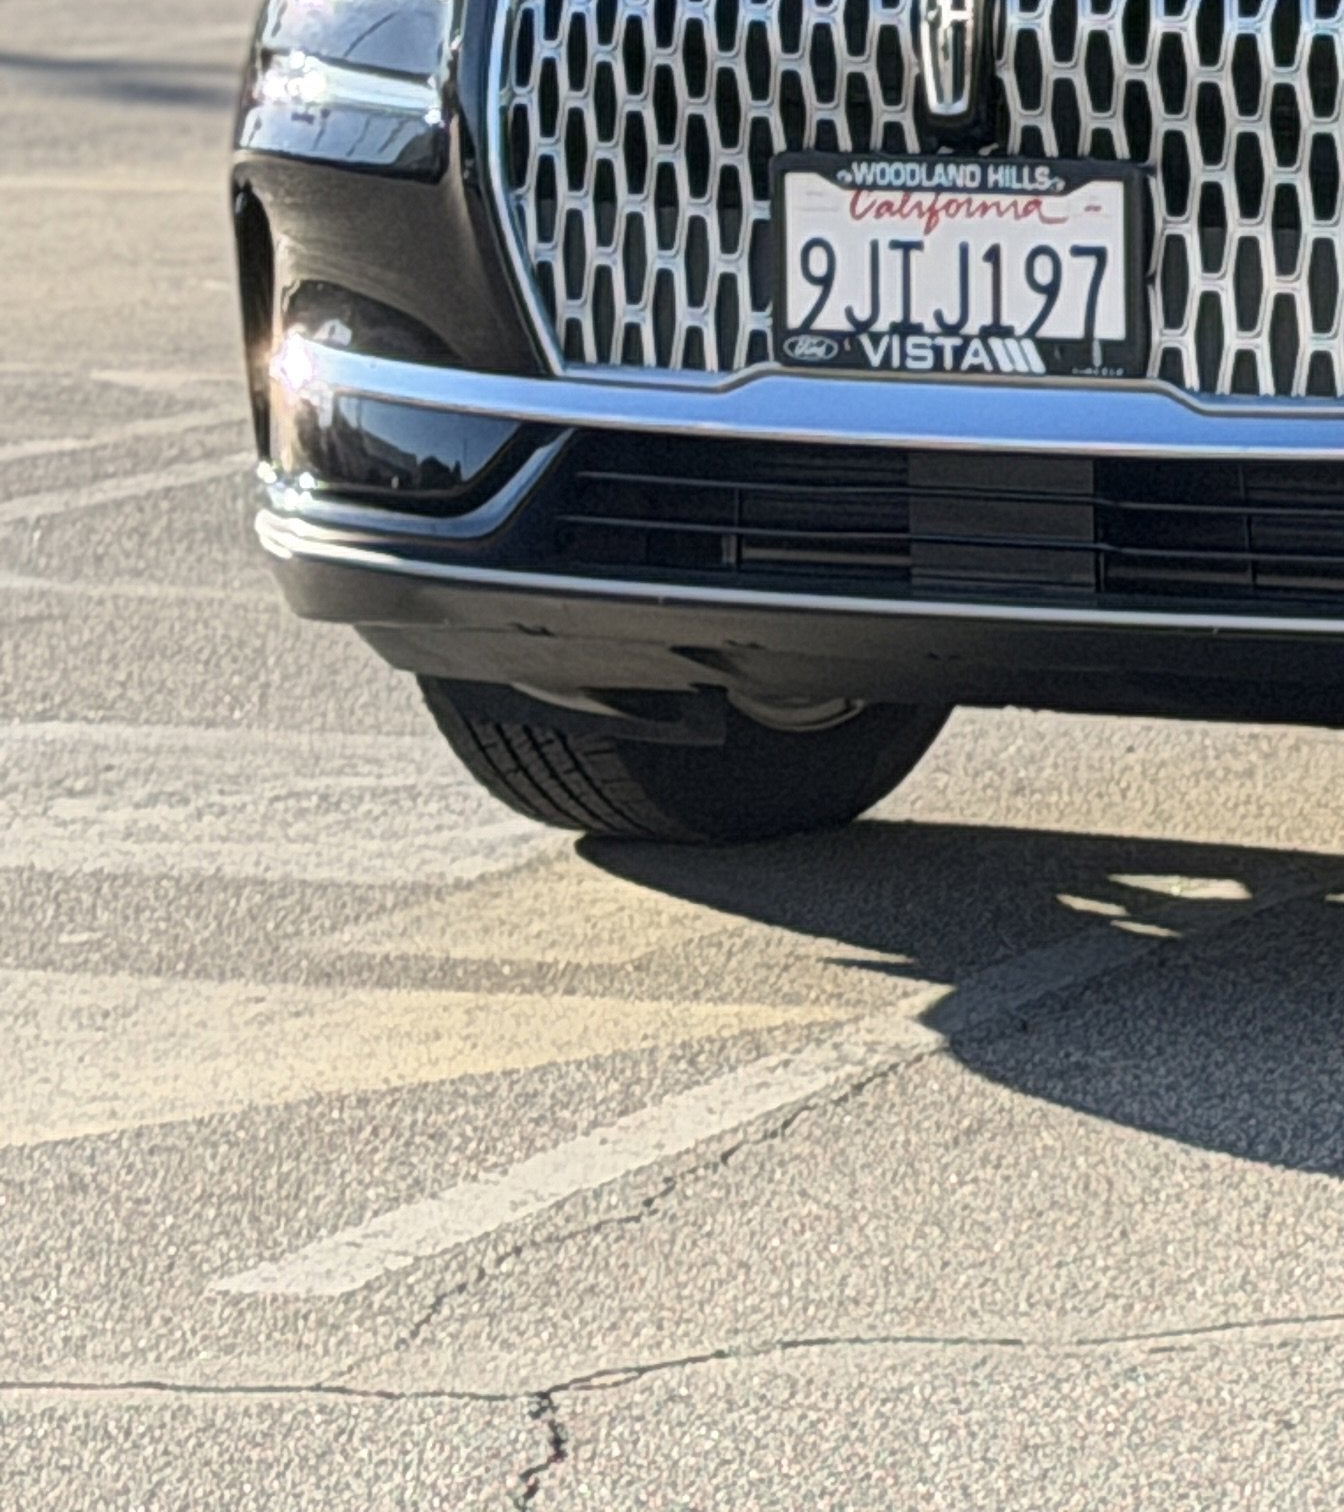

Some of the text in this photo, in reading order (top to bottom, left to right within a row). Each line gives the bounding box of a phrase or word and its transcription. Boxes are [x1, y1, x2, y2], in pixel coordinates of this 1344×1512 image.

[851, 161, 1051, 190] WOODLAND HILLS
[849, 188, 1068, 236] California
[860, 336, 994, 373] VISTA
